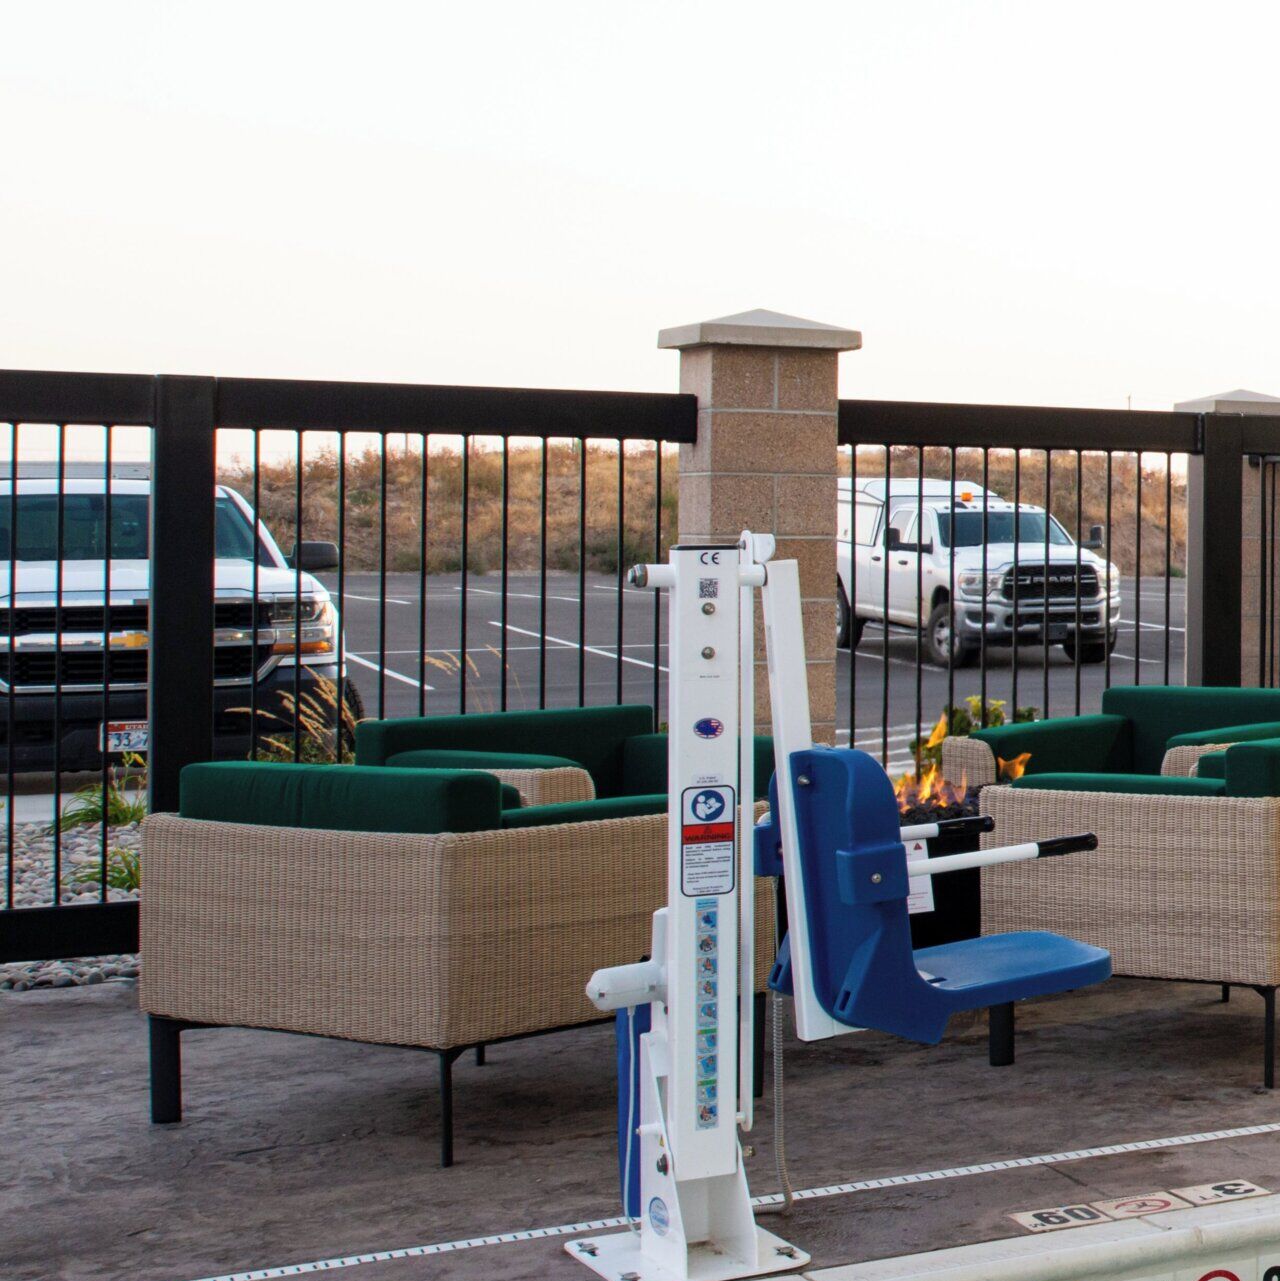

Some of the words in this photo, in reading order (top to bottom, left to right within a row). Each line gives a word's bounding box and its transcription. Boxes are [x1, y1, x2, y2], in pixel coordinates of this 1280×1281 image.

[700, 552, 720, 565] CE
[1033, 575, 1073, 584] RAM
[686, 832, 733, 842] WARNING
[1211, 1183, 1255, 1195] 3
